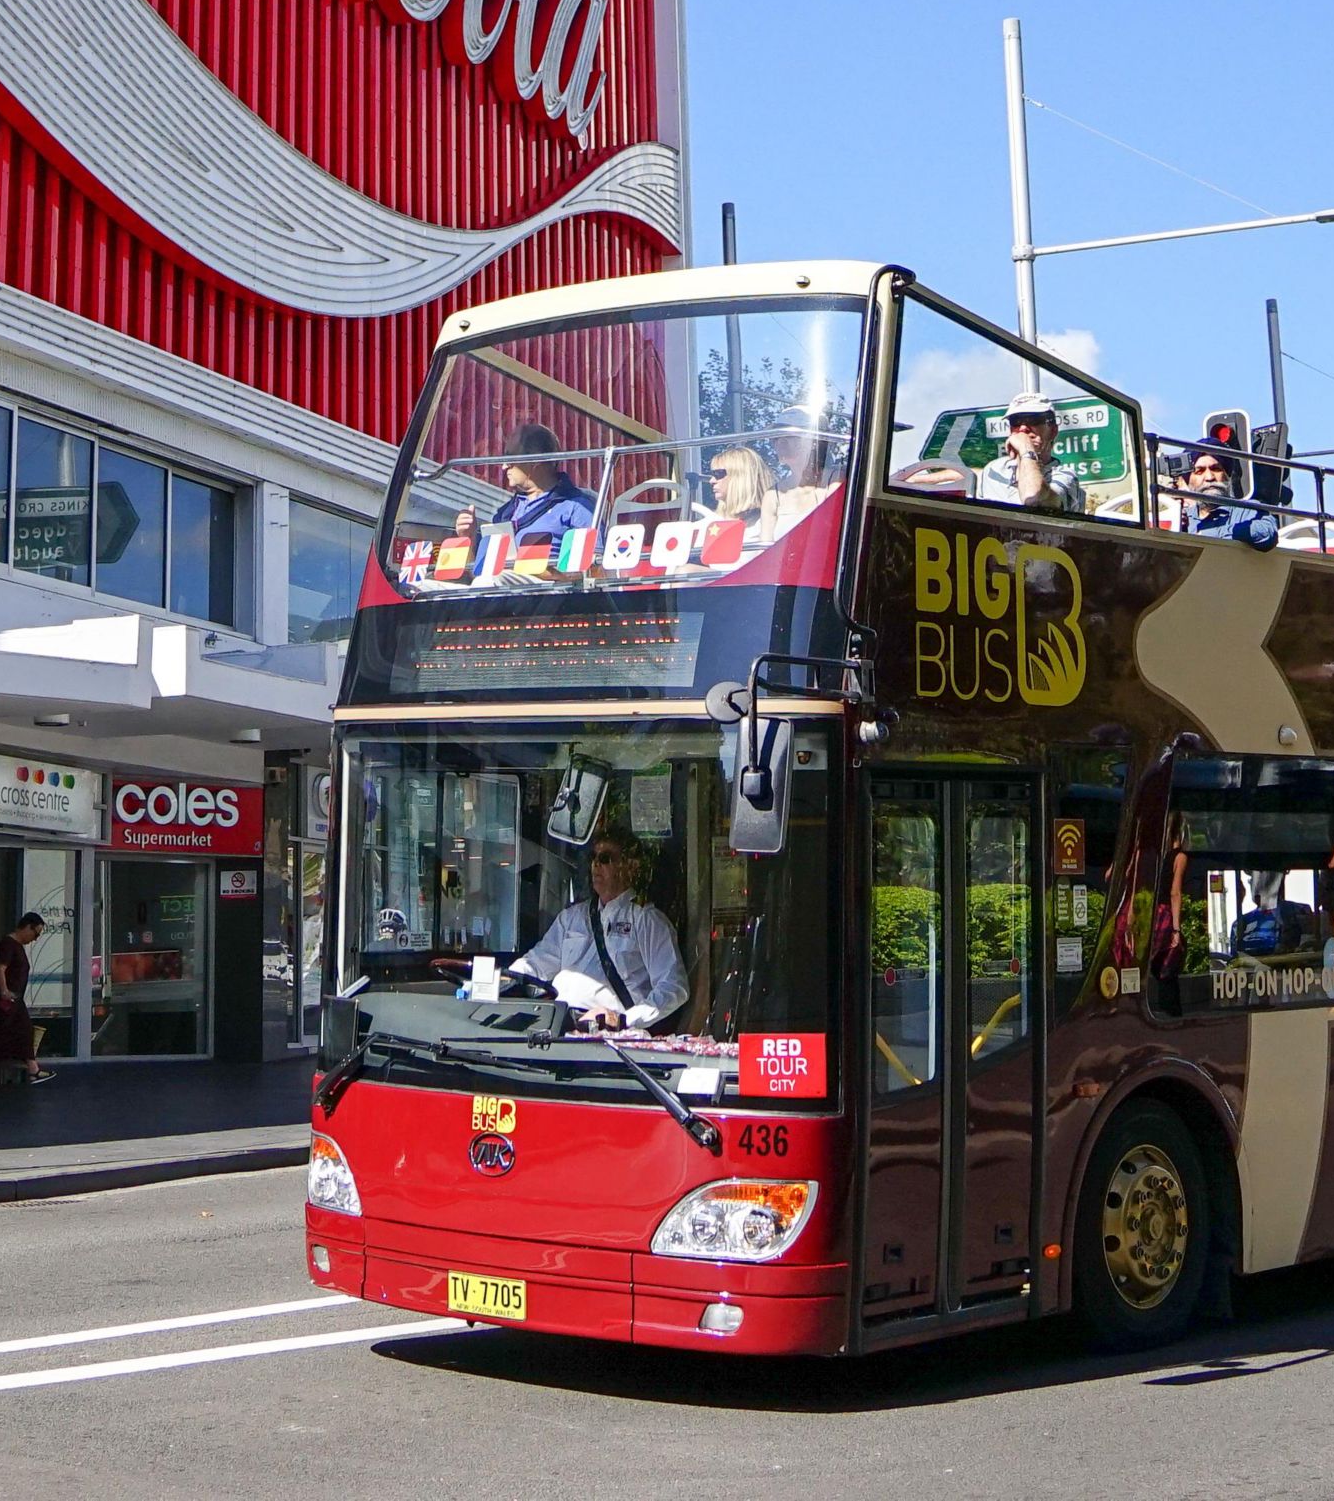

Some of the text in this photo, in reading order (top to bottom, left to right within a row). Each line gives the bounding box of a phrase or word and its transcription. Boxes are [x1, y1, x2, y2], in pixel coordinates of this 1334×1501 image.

[1087, 410, 1104, 422] RD
[915, 527, 1011, 619] BIG
[915, 621, 1012, 703] BUS
[0, 784, 30, 806] cross
[31, 790, 70, 812] centre
[115, 782, 239, 827] coles
[124, 828, 212, 849] Supermarket
[1213, 969, 1278, 999] HOP-ON
[762, 1038, 802, 1057] RED
[756, 1057, 808, 1076] TOUR
[769, 1079, 796, 1092] CITY
[472, 1095, 498, 1115] BIG
[471, 1113, 496, 1132] BUS
[738, 1124, 789, 1157] 436
